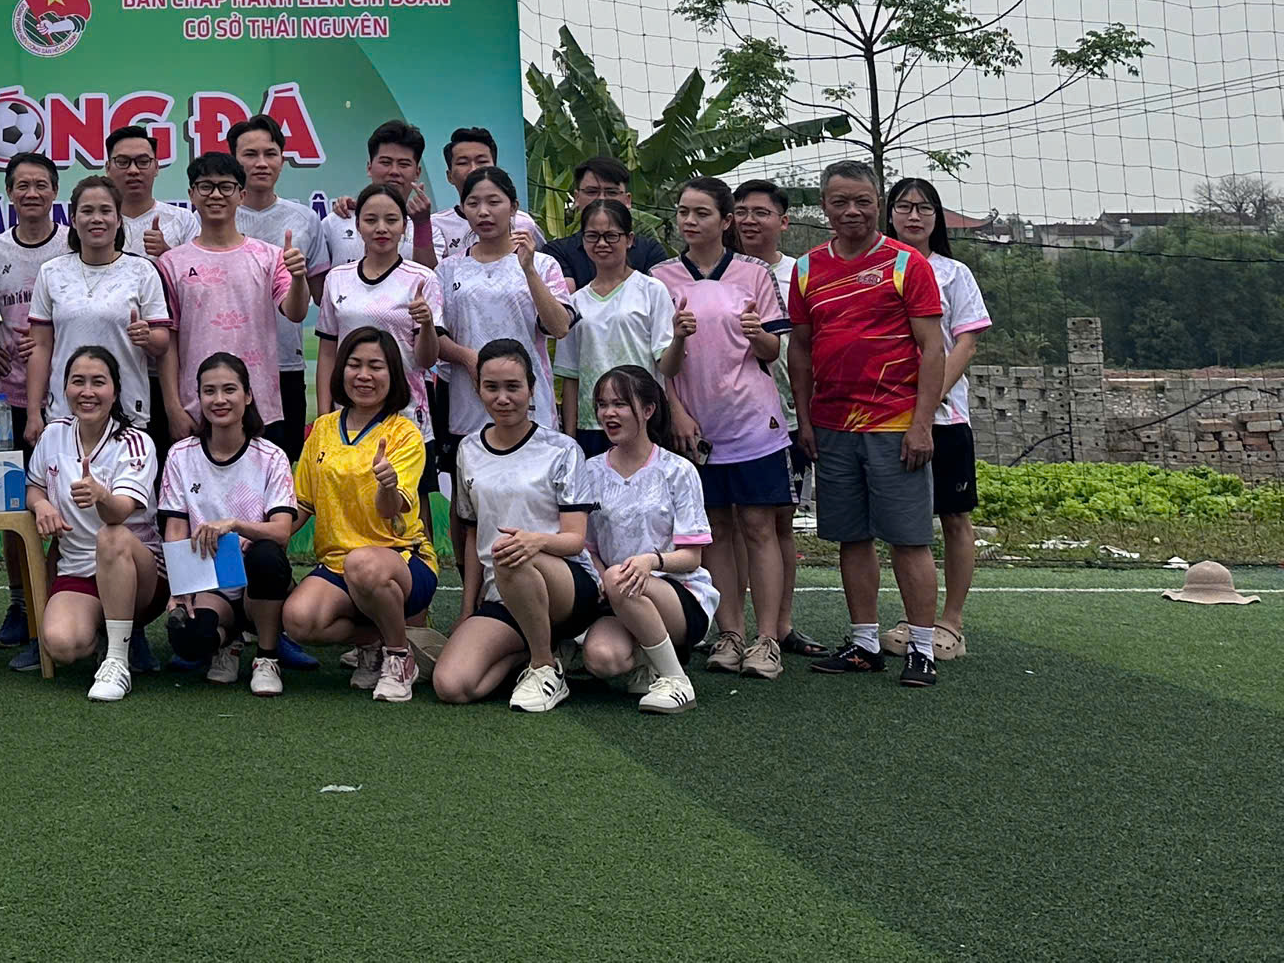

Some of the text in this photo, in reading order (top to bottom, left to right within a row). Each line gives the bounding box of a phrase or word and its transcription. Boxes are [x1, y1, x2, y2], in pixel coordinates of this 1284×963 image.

[184, 13, 389, 39] CƠ SỞ THÁI NGUYÊN
[194, 87, 321, 159] ĐÁ
